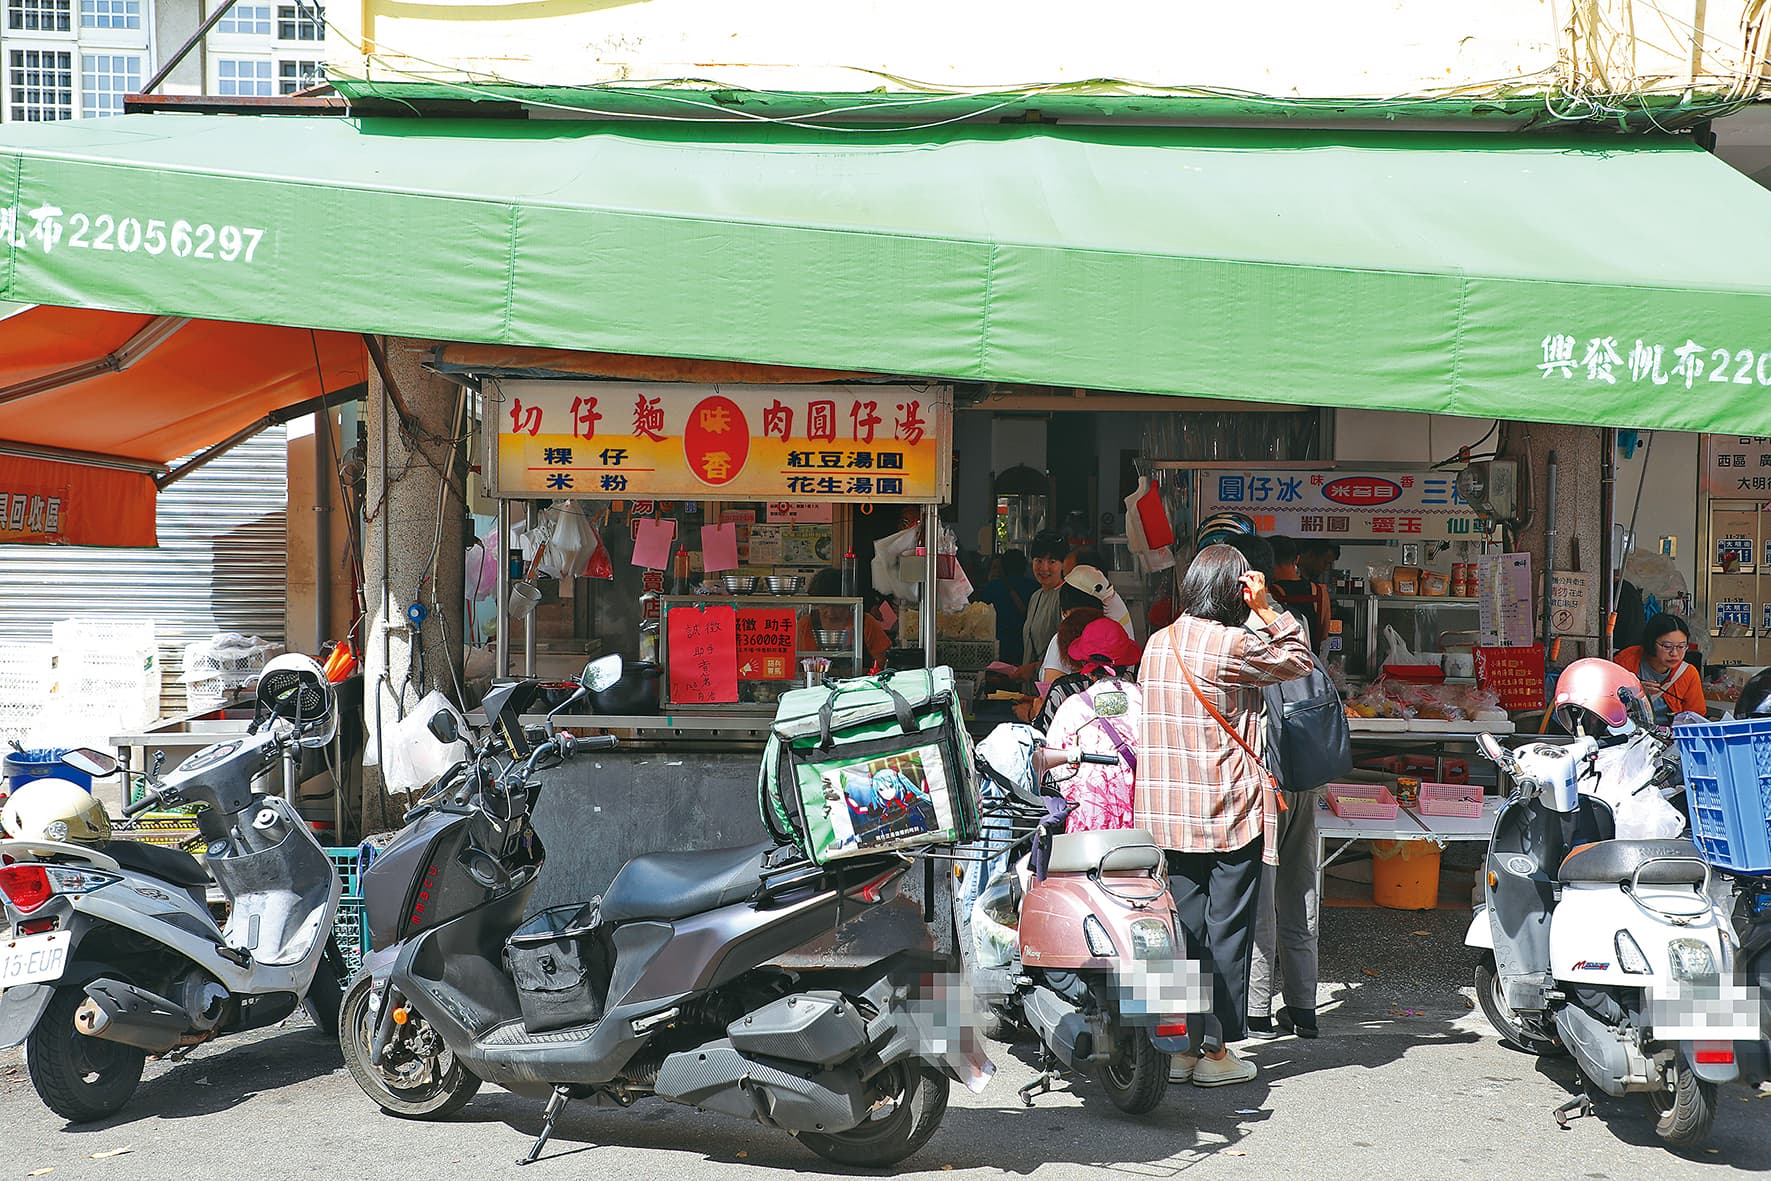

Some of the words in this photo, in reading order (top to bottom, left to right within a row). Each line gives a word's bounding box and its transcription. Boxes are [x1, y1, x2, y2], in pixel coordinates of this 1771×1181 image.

[509, 393, 668, 443] 切仔麵
[763, 398, 926, 446] 肉圓仔湯
[699, 405, 732, 481] 味香
[543, 447, 629, 467] 粿仔
[786, 450, 904, 470] 紅豆湯圓
[1718, 454, 1746, 468] 西區
[545, 472, 629, 492] 米粉
[786, 476, 904, 496] 花生湯圓
[1218, 475, 1303, 503] 圓仔冰
[1737, 477, 1771, 490] 大明
[1301, 516, 1350, 533] 粉圓
[764, 618, 793, 632] 助手
